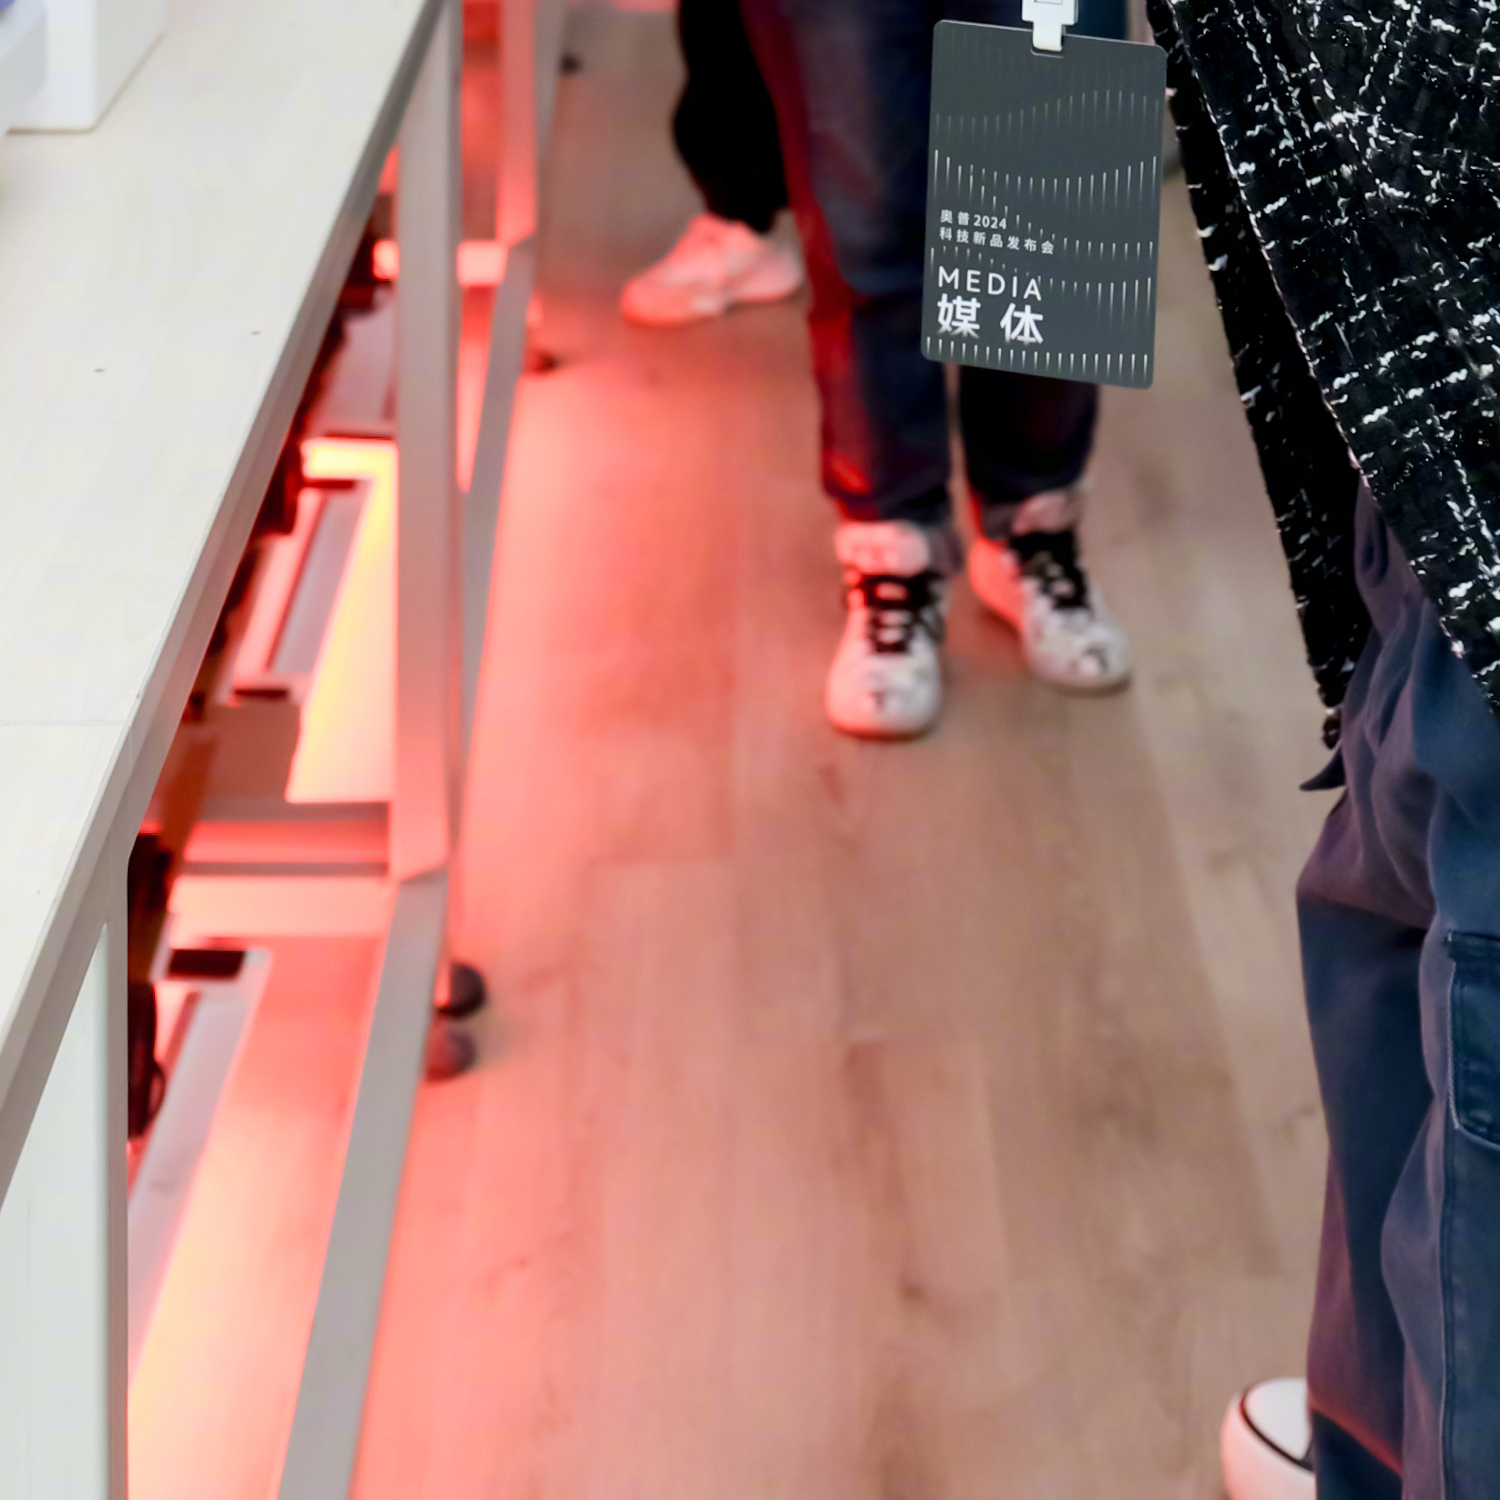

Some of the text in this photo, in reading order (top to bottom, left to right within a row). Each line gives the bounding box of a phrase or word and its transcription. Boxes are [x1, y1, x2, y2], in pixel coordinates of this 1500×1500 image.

[939, 226, 1055, 255] 科技新品发布会
[938, 265, 1042, 301] MEDIA
[937, 293, 1044, 345] 媒体
